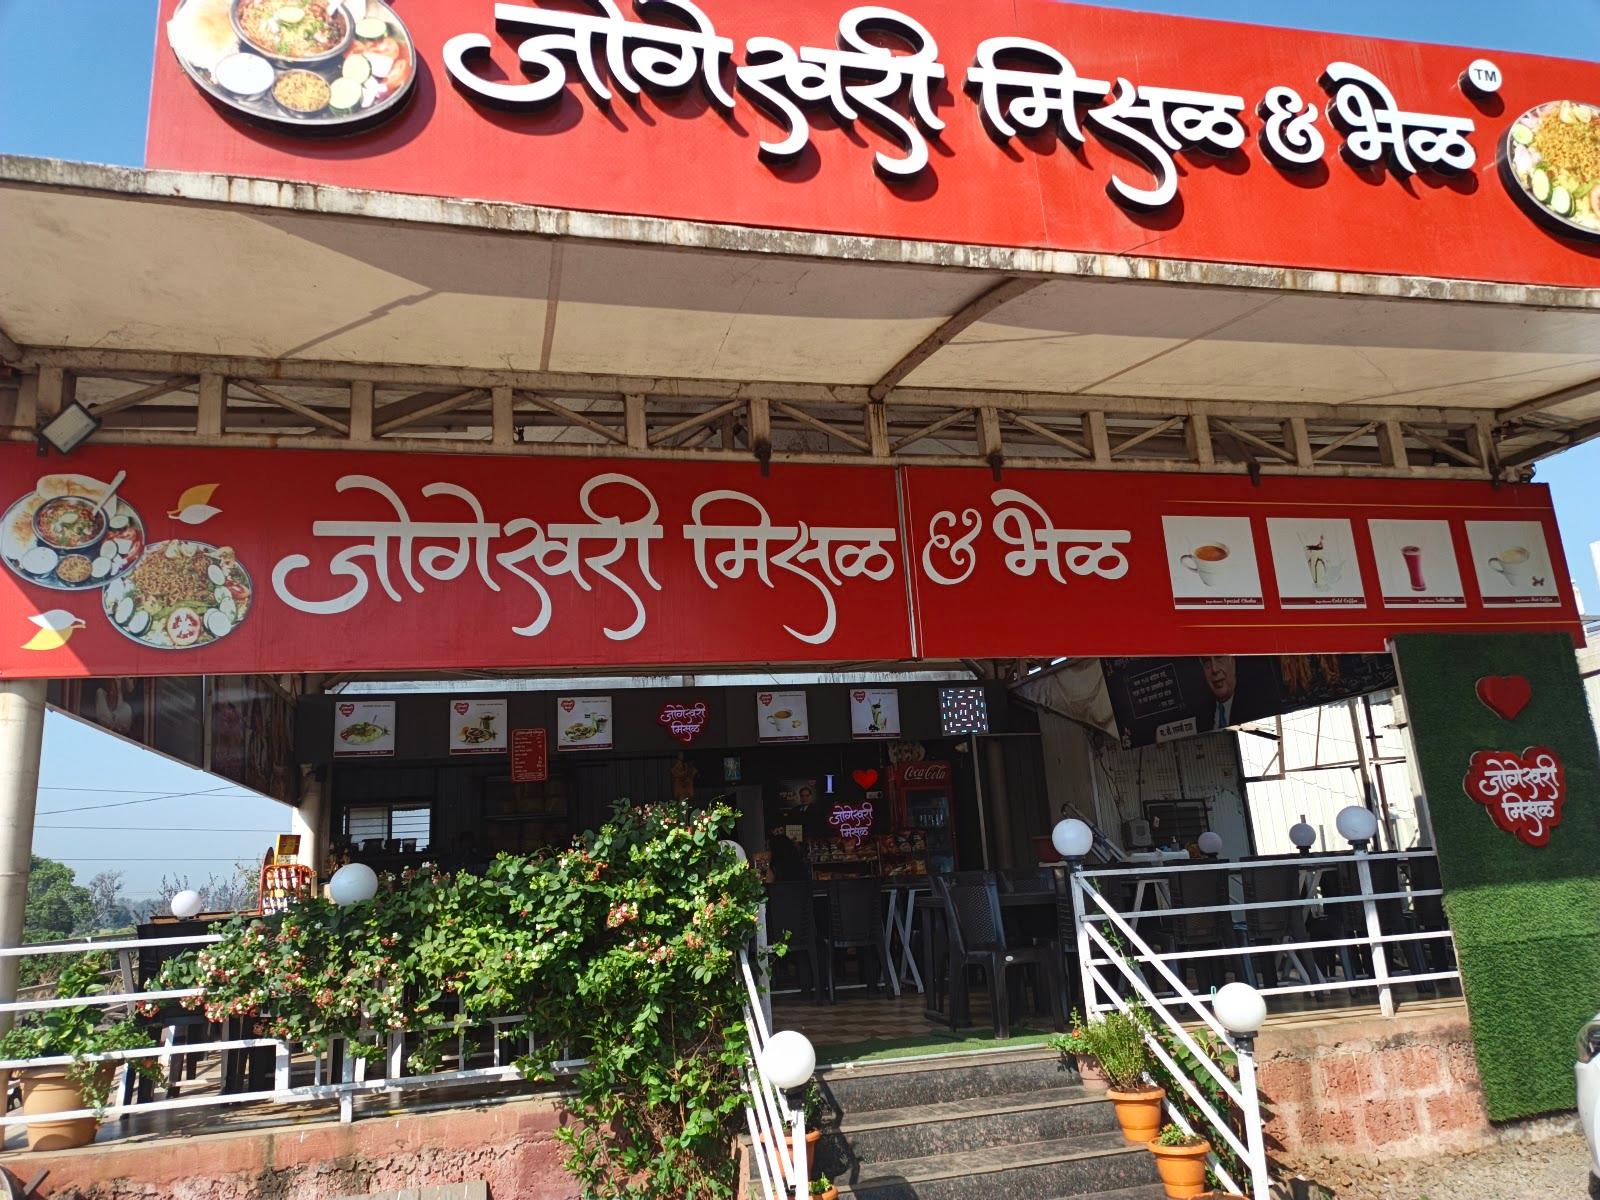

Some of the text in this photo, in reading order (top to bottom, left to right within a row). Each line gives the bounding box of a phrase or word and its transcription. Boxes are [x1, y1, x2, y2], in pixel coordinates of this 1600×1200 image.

[1473, 68, 1498, 83] TM
[967, 36, 1246, 206] मिसळ
[1263, 86, 1326, 164] &
[1326, 61, 1477, 174] भेळ
[683, 489, 896, 645] मिसळ
[922, 507, 981, 586] &
[990, 488, 1132, 584] भेळ
[671, 720, 700, 742] मिसळ
[824, 774, 835, 794] I
[1502, 792, 1553, 836] मिसळ
[839, 823, 869, 846] मिसळ
